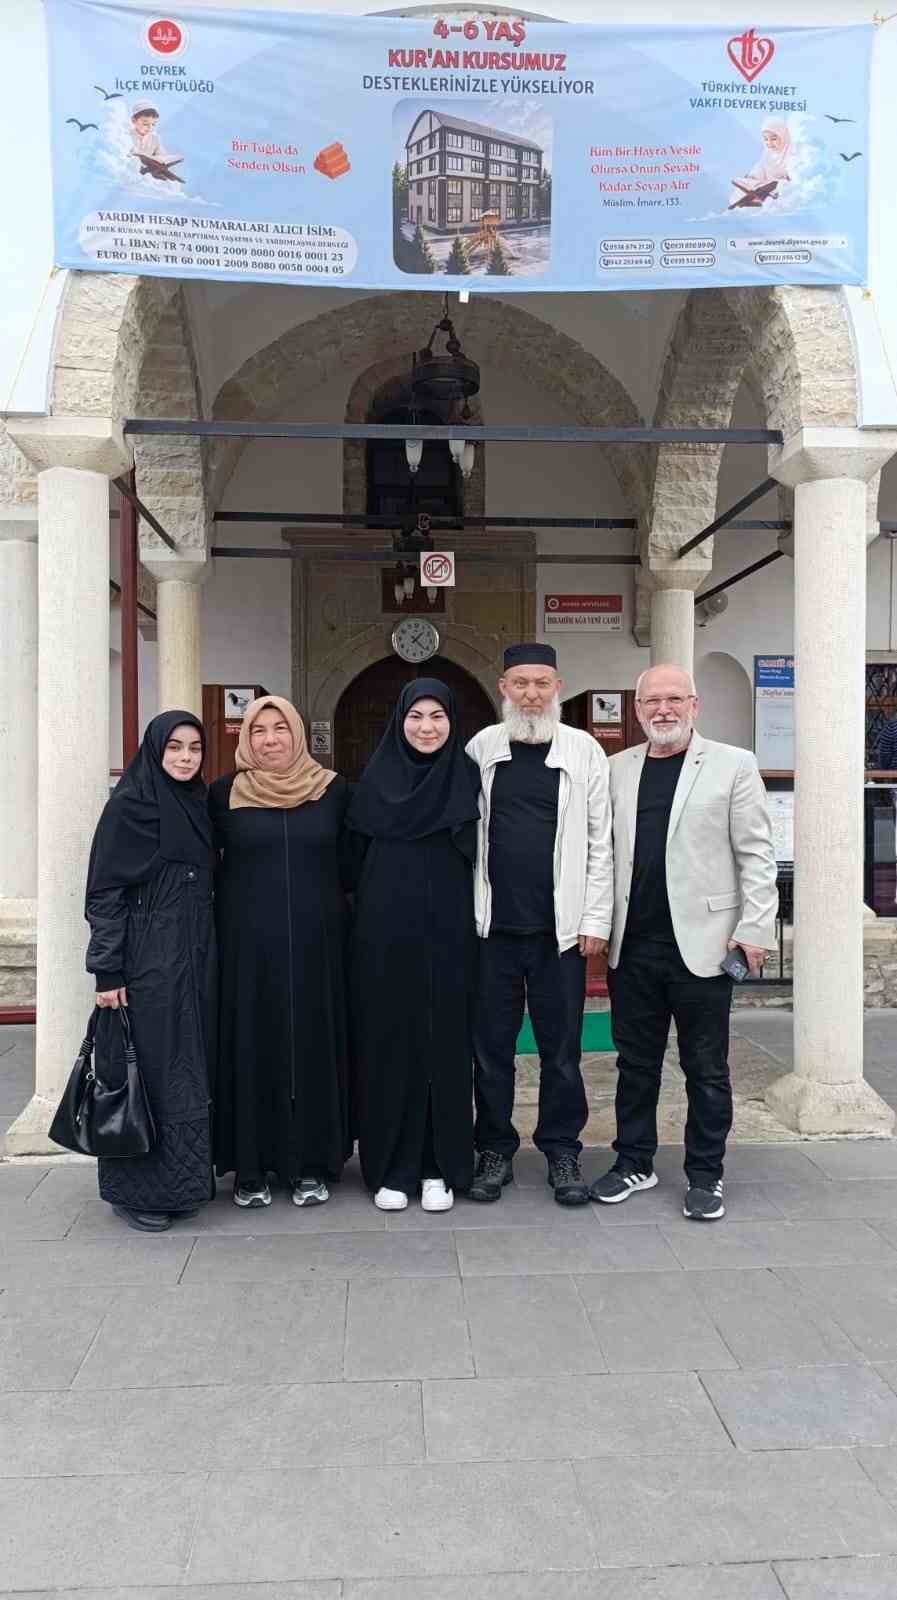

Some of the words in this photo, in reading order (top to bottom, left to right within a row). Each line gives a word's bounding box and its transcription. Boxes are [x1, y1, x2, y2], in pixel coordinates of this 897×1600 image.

[433, 19, 479, 40] 4-6
[483, 20, 527, 47] YAŞ
[388, 48, 459, 69] KUR'AN
[462, 50, 567, 71] KURSUMUZ
[140, 65, 187, 76] DEVREK
[115, 78, 139, 92] İLÇE
[142, 79, 214, 93] MÜFTÜLÜĞÜ
[362, 75, 498, 93] DESTEKLERİNİZLE
[501, 76, 594, 95] YÜKSELİYOR
[701, 81, 748, 94] TÜRKİYE
[750, 83, 798, 96] DİYANET
[689, 98, 722, 109] VAKFI
[724, 98, 767, 110] DEVREK
[768, 100, 807, 112] ŞUBESİ
[232, 140, 248, 152] Bir
[251, 142, 282, 155] Tuğla
[284, 144, 298, 155] da
[615, 146, 631, 157] Bir
[634, 146, 667, 159] Hayra
[670, 144, 702, 156] Vesile
[227, 158, 270, 171] Senden
[272, 161, 306, 174] Olsun
[591, 164, 628, 174] Olursa
[630, 163, 661, 174] Onun
[599, 181, 633, 192] Kadar
[635, 180, 668, 193] Sevap
[98, 211, 145, 223] YARDIM
[149, 215, 188, 227] HESAP
[191, 219, 269, 233] NUMARALARI
[272, 224, 303, 236] ALICI
[307, 224, 337, 237] İSİM:
[113, 238, 126, 247] TL
[129, 239, 160, 249] IBAN:
[161, 241, 177, 250] TR
[180, 243, 192, 252] 74
[195, 244, 219, 254] 0001
[223, 246, 248, 255] 2009
[96, 250, 128, 260] EURO
[130, 252, 160, 262] IBAN:
[162, 255, 178, 264] TR
[196, 257, 221, 267] 0001
[224, 259, 248, 268] 2009
